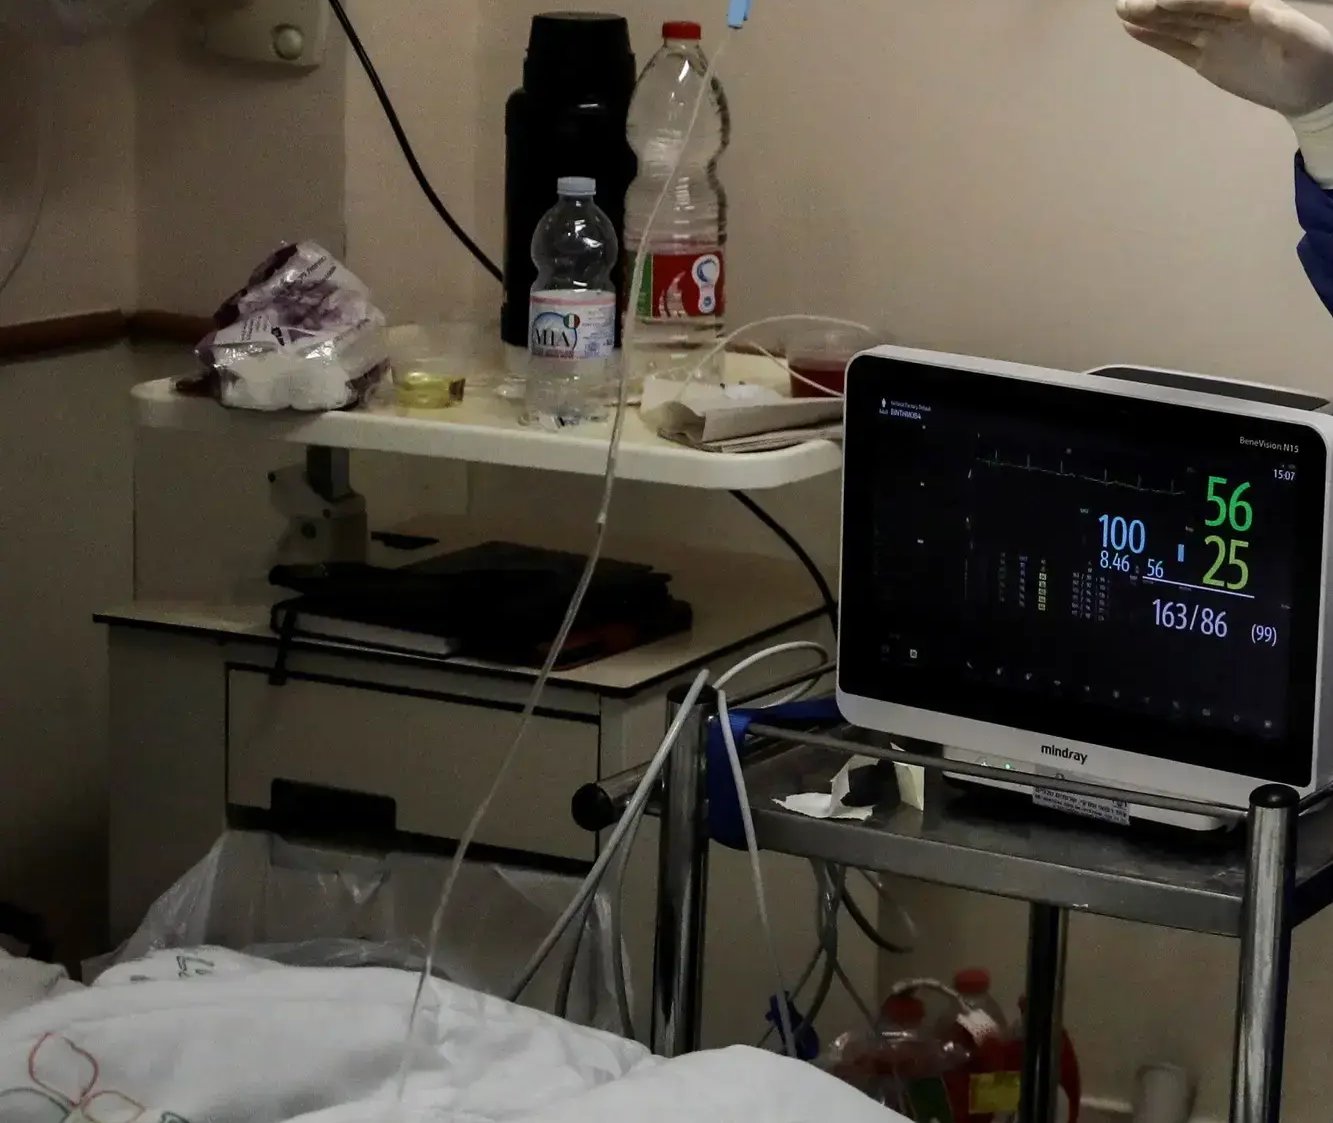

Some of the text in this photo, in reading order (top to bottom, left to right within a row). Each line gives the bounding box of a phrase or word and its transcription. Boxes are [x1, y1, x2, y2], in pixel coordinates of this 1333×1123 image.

[1239, 436, 1299, 453] BeneVision N15
[1205, 476, 1253, 532] 56
[1099, 514, 1146, 554] 100
[1100, 550, 1130, 573] 8.46
[1147, 558, 1164, 579] 56
[1202, 535, 1250, 590] 25
[1152, 598, 1228, 638] 163/86
[1250, 623, 1277, 647] (99)
[1041, 744, 1088, 765] mindray
